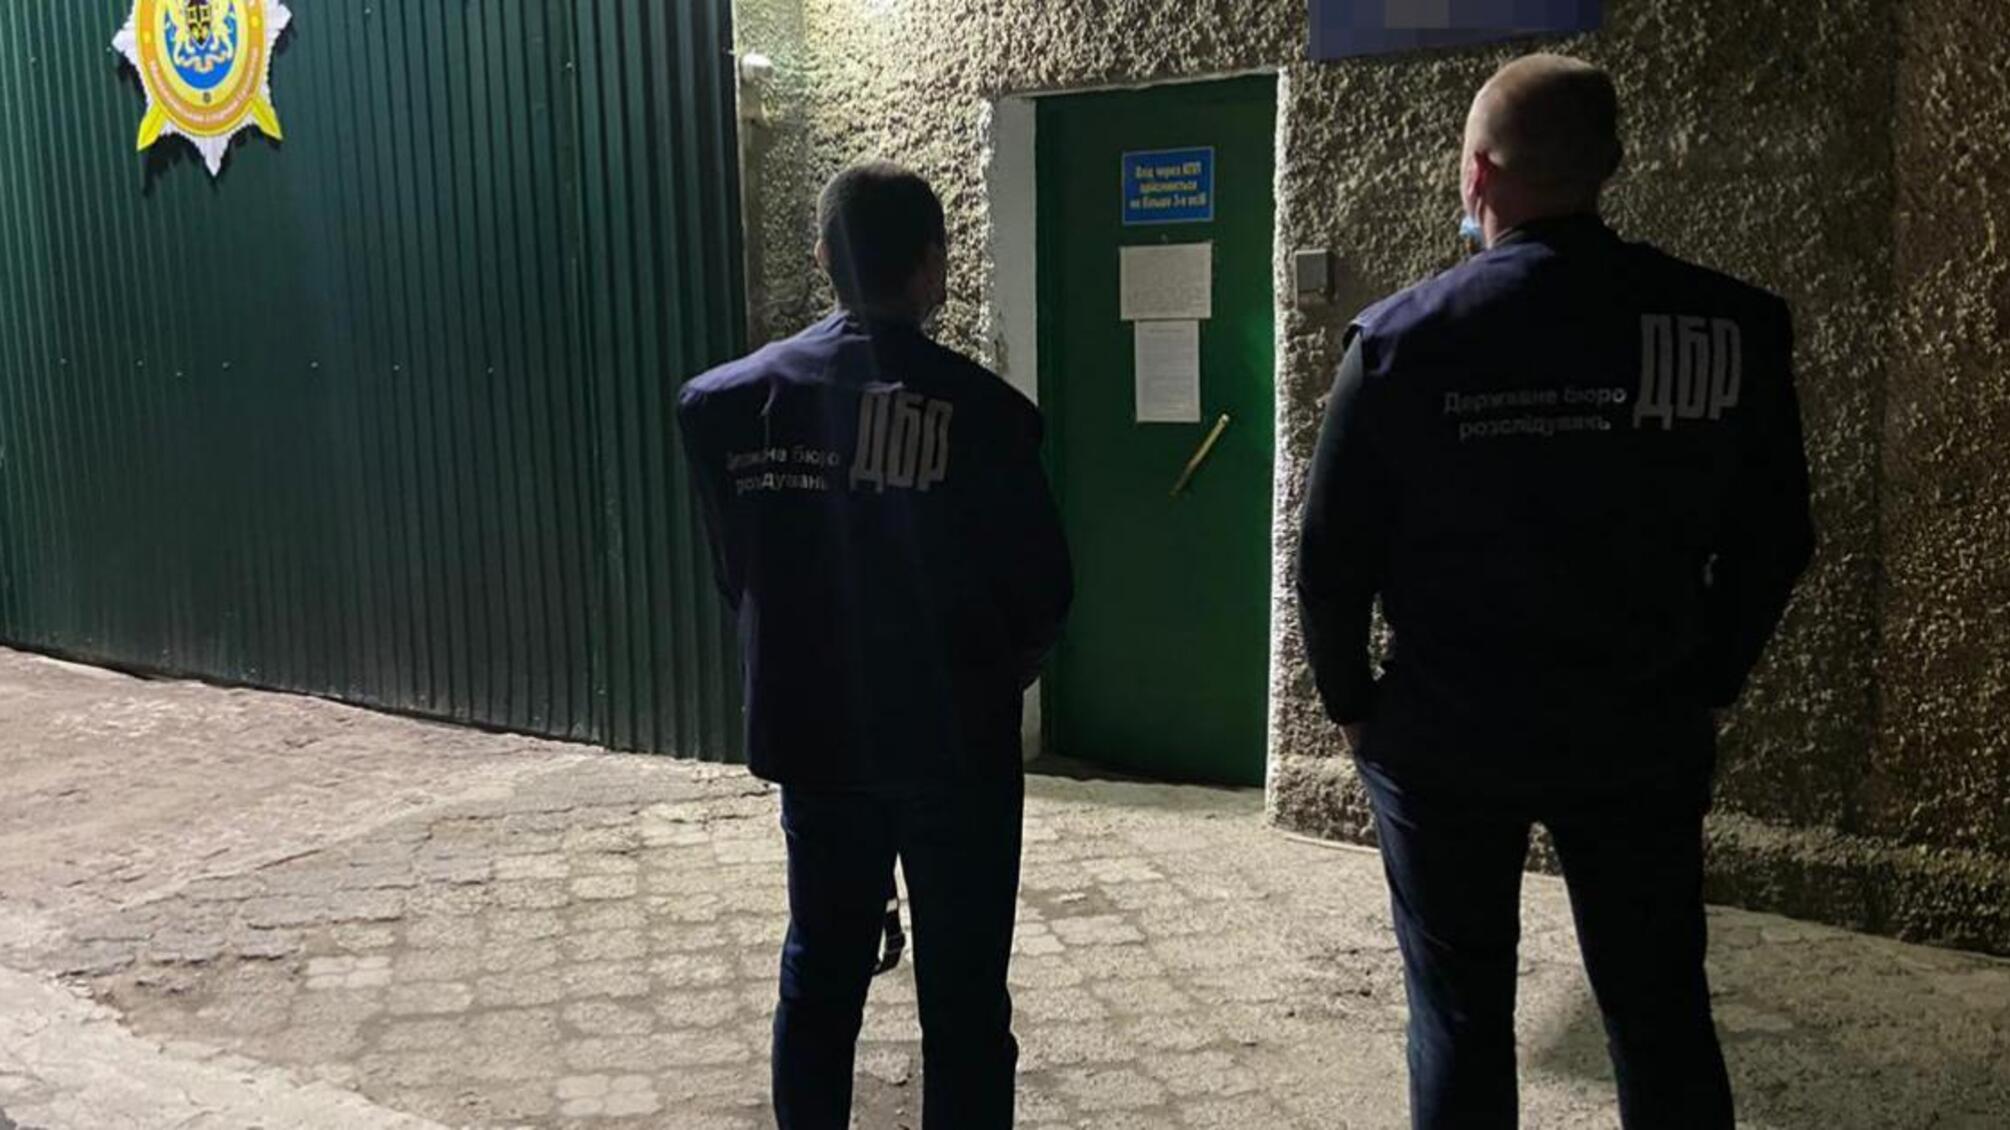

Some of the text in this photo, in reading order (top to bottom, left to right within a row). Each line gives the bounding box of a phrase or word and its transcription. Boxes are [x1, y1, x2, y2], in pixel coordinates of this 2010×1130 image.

[1442, 386, 1628, 414] Державне бюро
[1631, 313, 1743, 430] ДБР
[849, 391, 953, 493] ДБР
[1458, 417, 1612, 441] розслідувань
